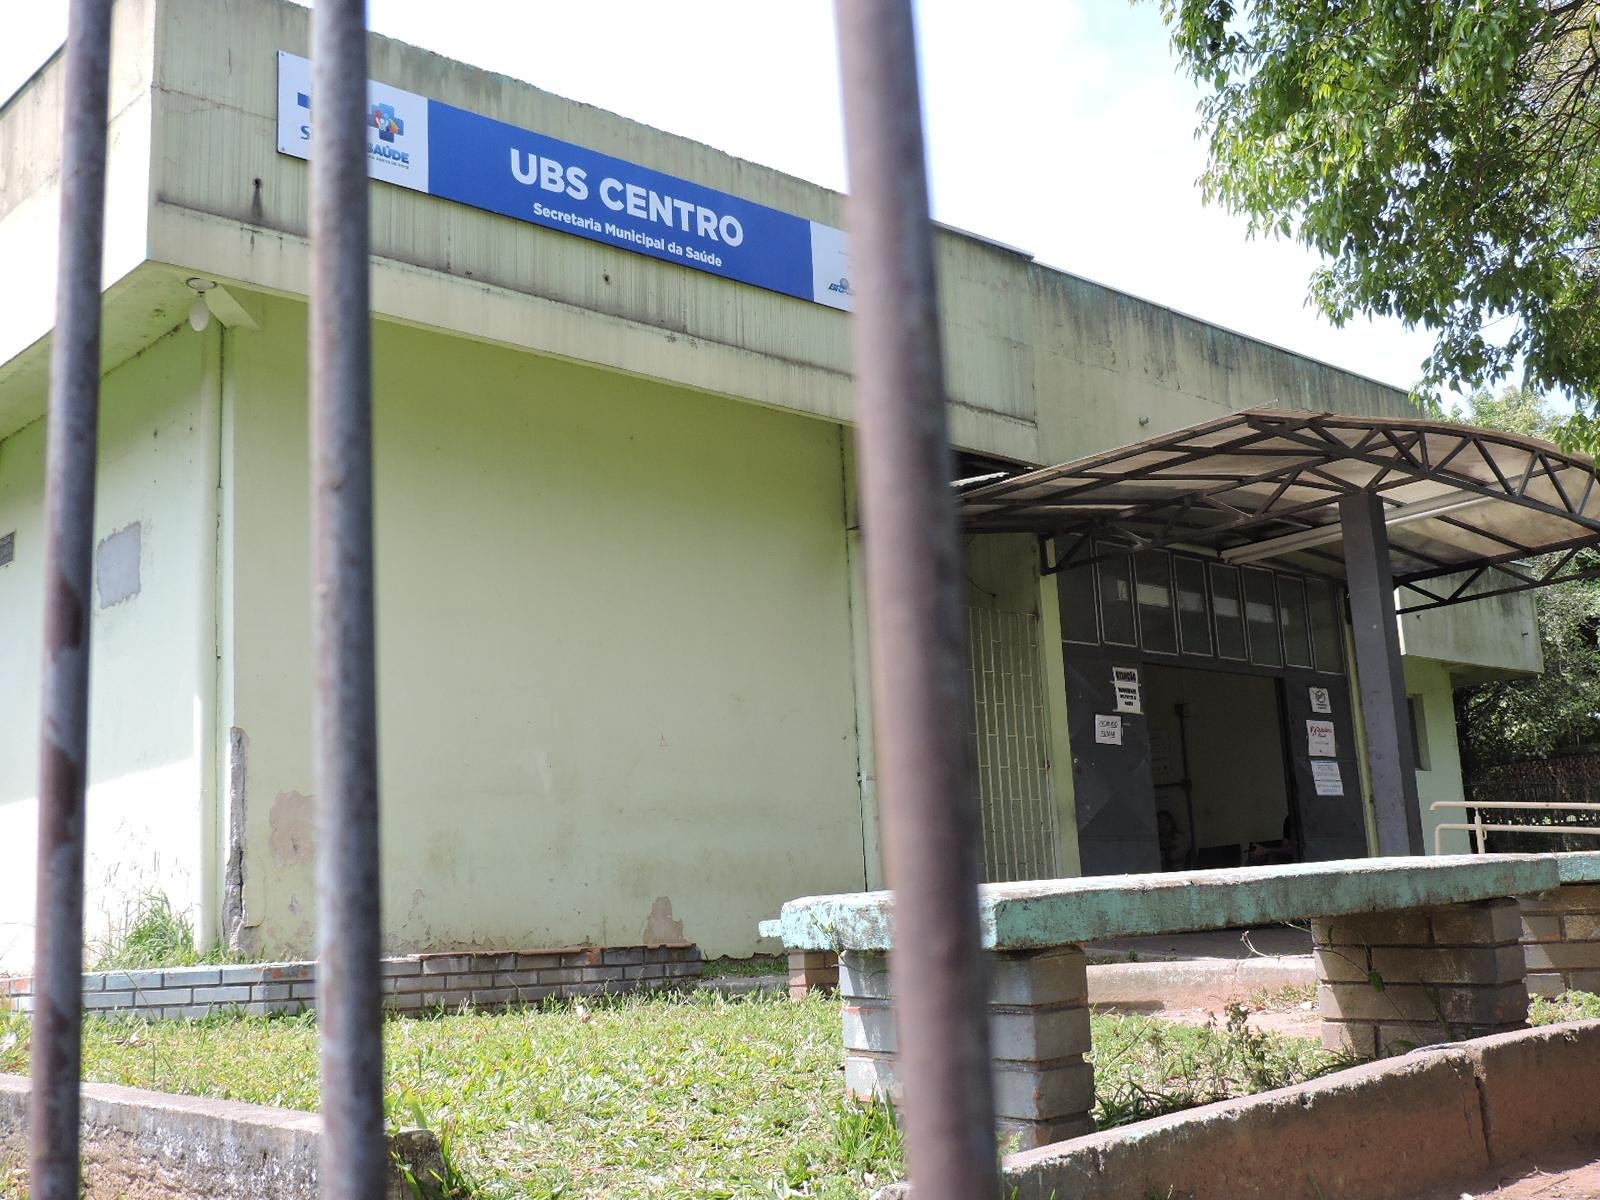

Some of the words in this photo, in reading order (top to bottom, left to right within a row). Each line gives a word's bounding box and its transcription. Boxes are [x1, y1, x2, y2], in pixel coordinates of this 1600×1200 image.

[367, 142, 410, 165] SAÚDE
[510, 148, 589, 200] UBS
[599, 177, 744, 248] CENTRO
[533, 202, 602, 233] Secretaria
[605, 222, 665, 251] Municipal
[667, 241, 683, 256] da
[685, 246, 722, 267] Saúde
